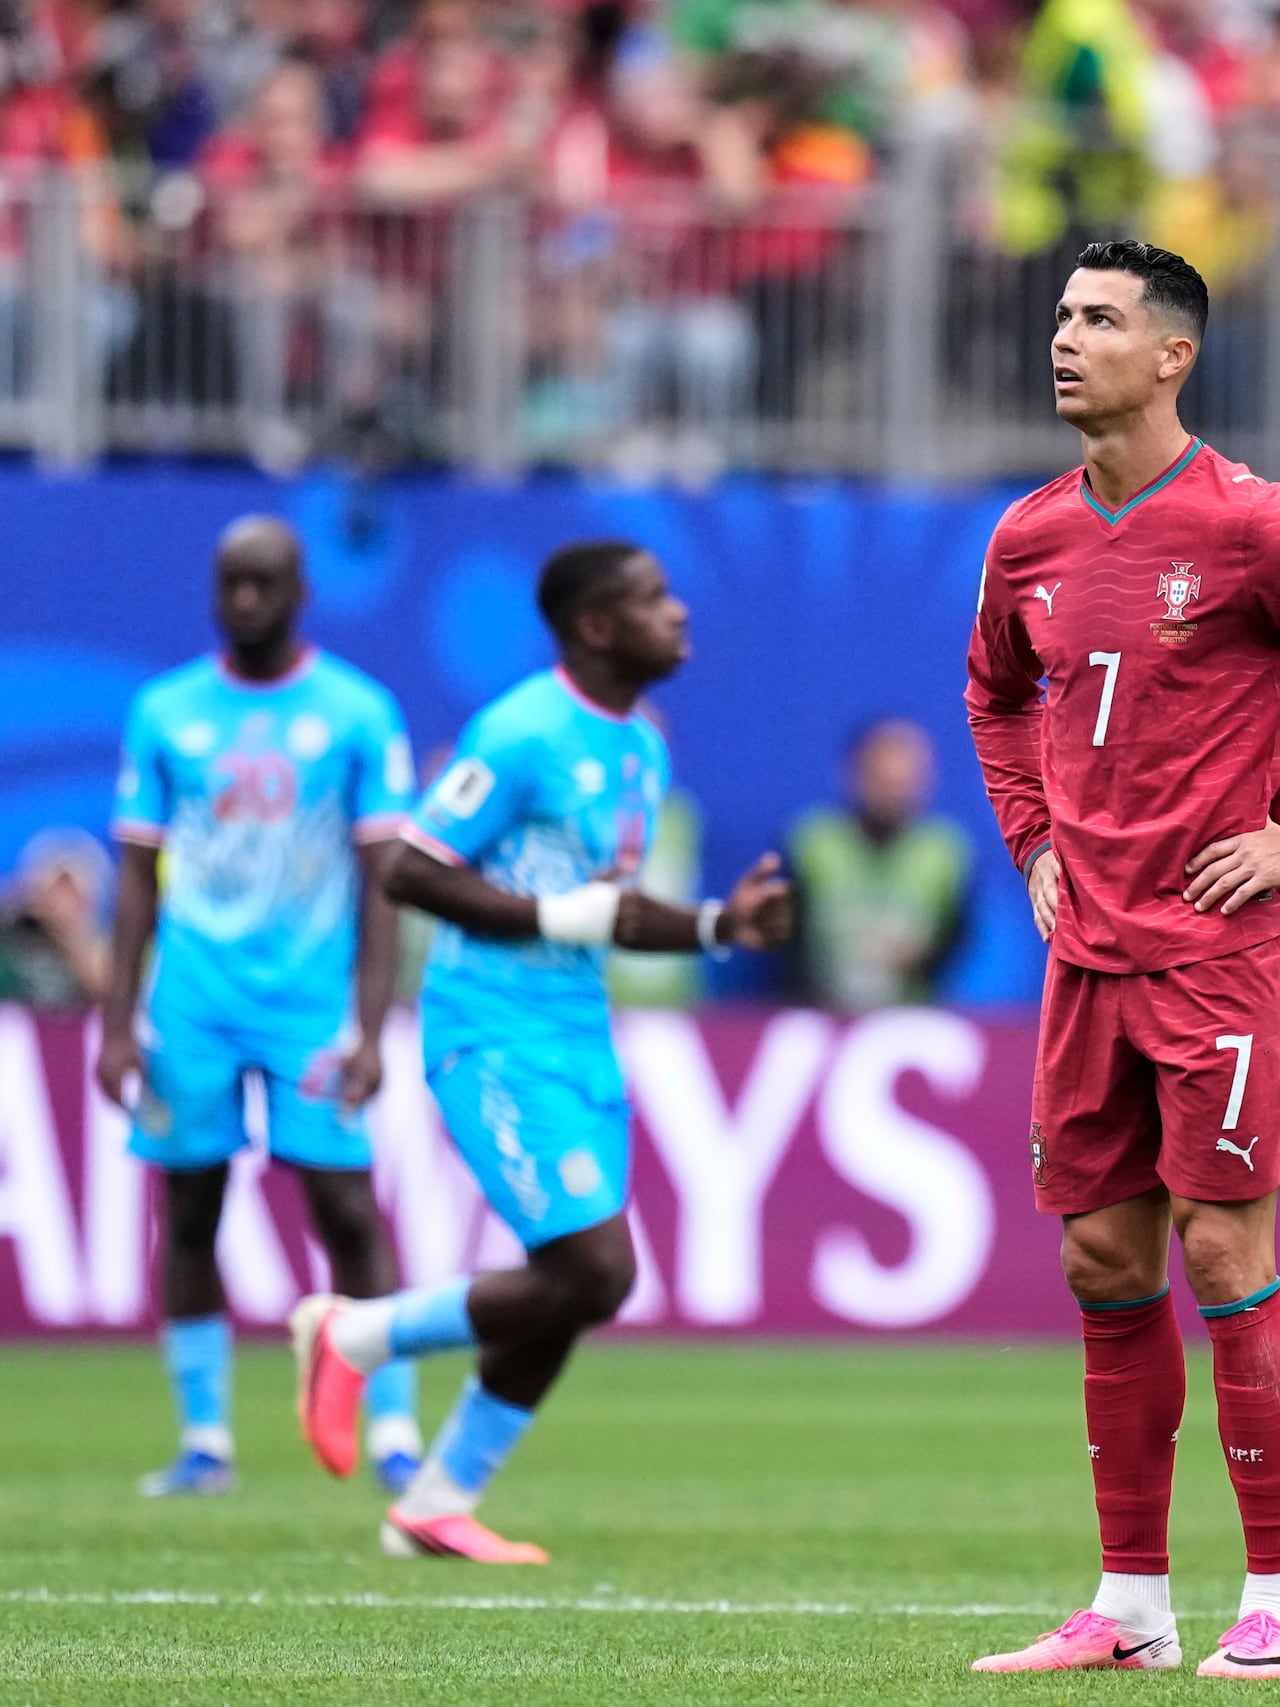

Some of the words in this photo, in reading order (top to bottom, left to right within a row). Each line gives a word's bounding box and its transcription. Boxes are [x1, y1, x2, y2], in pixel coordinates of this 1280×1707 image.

[1088, 651, 1122, 747] 7
[214, 753, 296, 822] 20
[1215, 1034, 1254, 1130] 7
